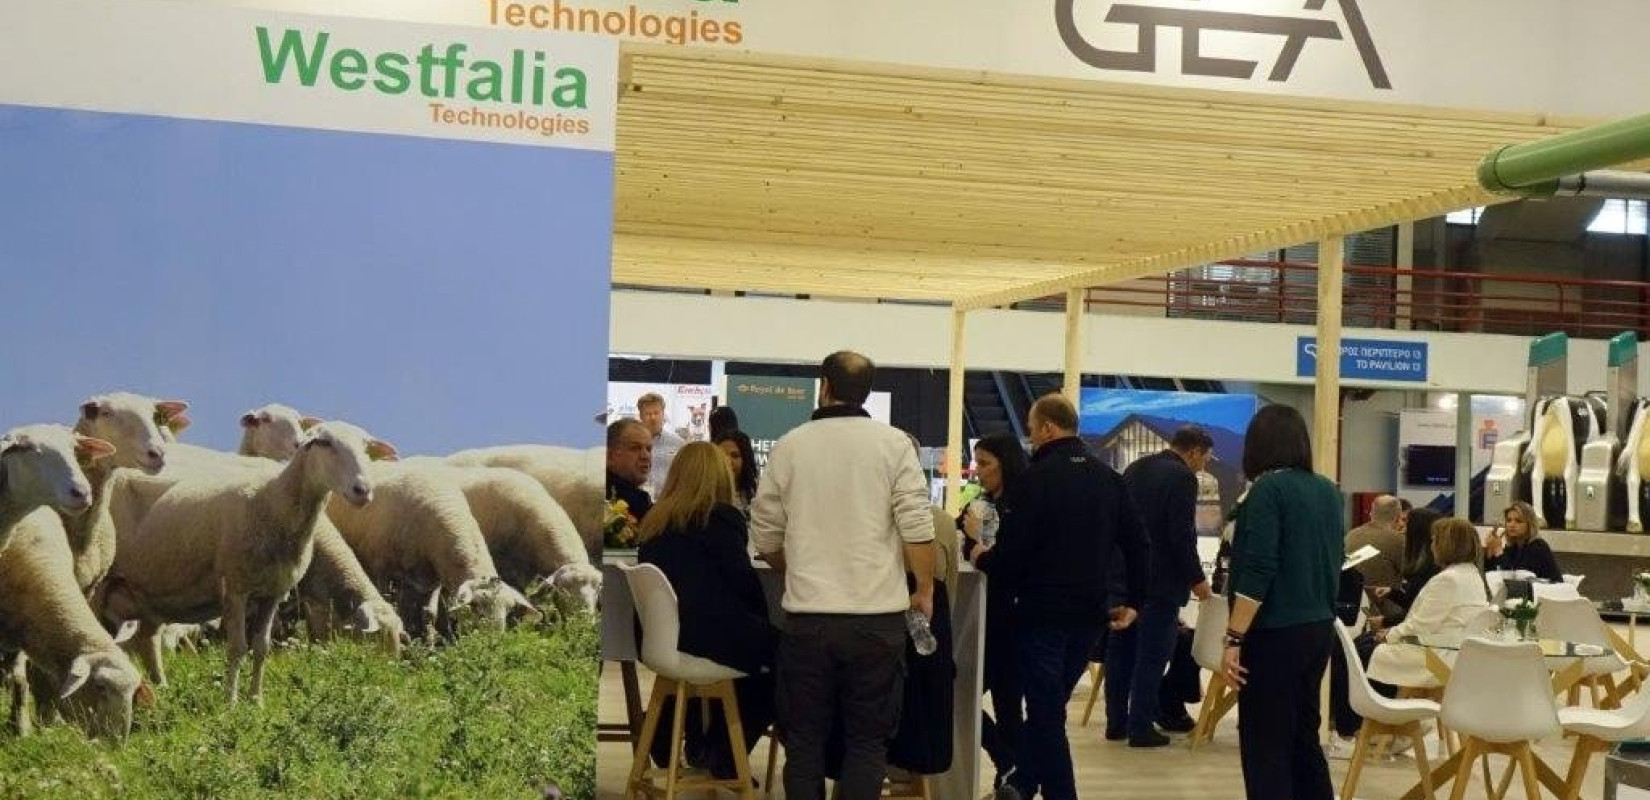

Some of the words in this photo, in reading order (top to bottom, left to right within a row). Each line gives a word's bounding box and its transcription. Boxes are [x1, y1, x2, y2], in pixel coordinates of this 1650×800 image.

[489, 0, 743, 45] Technologies
[1054, 0, 1392, 90] GEA
[256, 26, 588, 109] Westfalia
[429, 103, 590, 135] Technologies
[1356, 359, 1368, 369] TO
[1369, 360, 1410, 371] PAVILION
